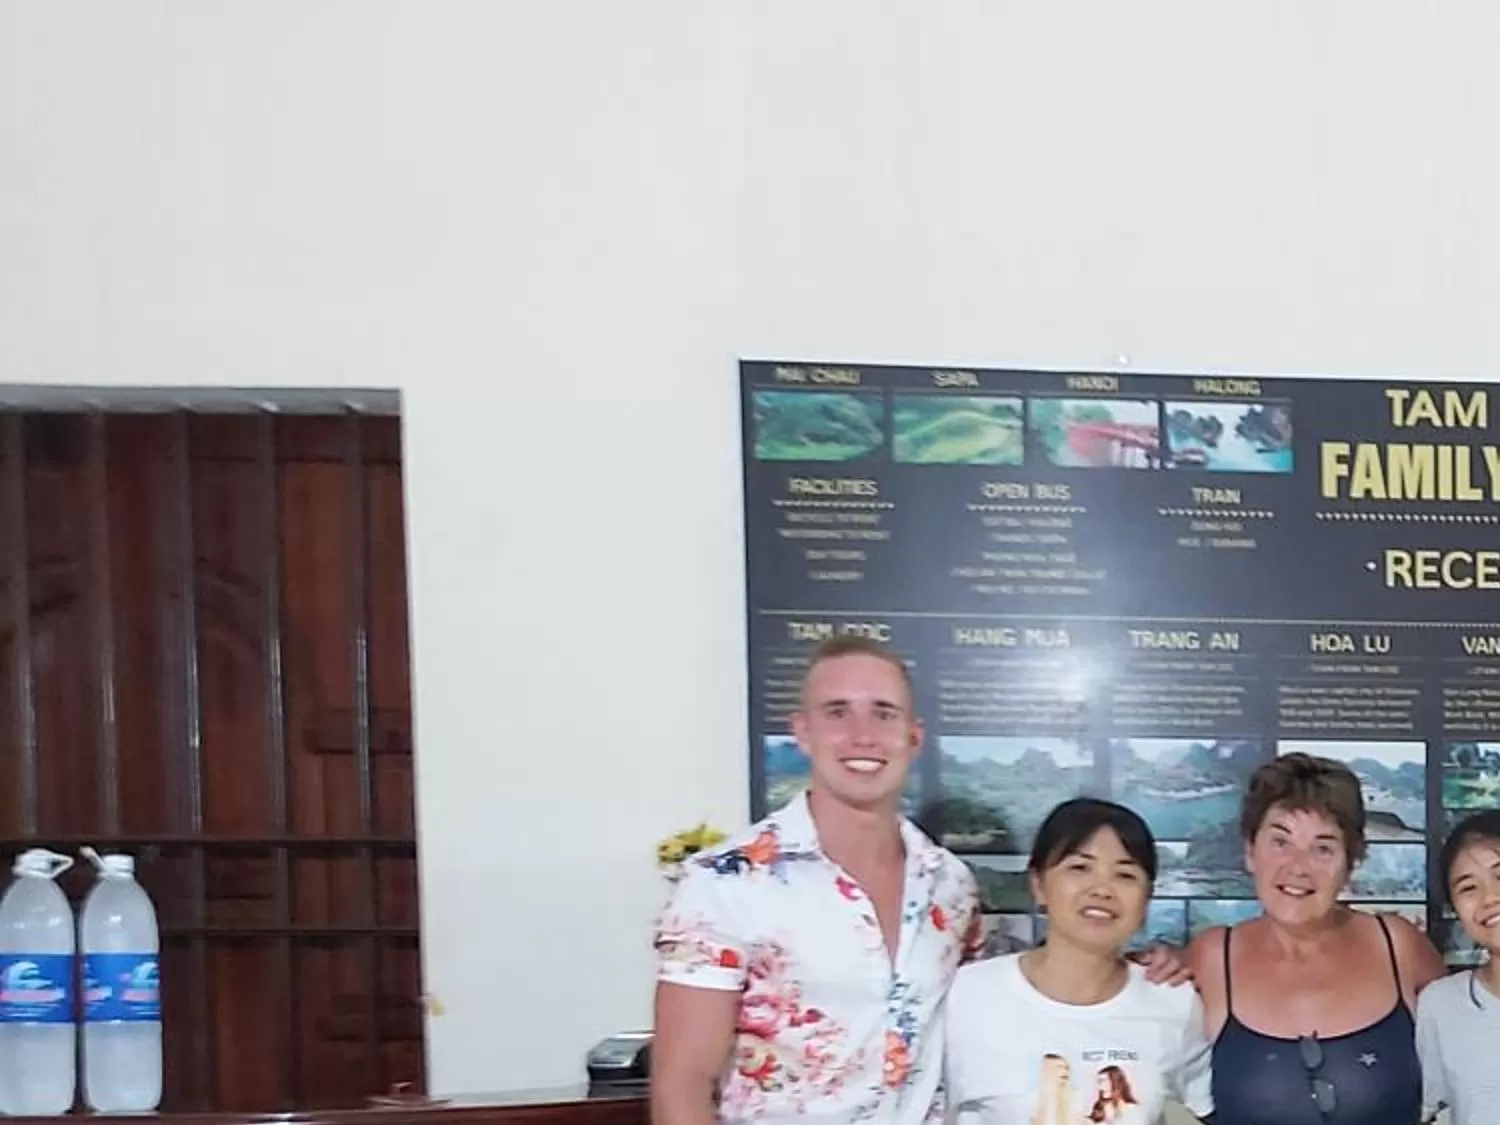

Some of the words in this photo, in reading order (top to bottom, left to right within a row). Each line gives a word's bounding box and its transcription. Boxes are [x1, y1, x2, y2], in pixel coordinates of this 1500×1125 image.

[1066, 375, 1119, 392] HANOI
[1193, 378, 1261, 396] HALONG
[1384, 388, 1488, 429] TAM
[981, 482, 1030, 500] OPEN
[1033, 482, 1072, 500] BUS
[1191, 486, 1242, 505] TRAIN
[953, 627, 1018, 647] HANG
[1127, 629, 1200, 650] TRANG
[1209, 632, 1240, 651] AN
[1310, 633, 1356, 653] HOA
[1363, 634, 1392, 653] LU
